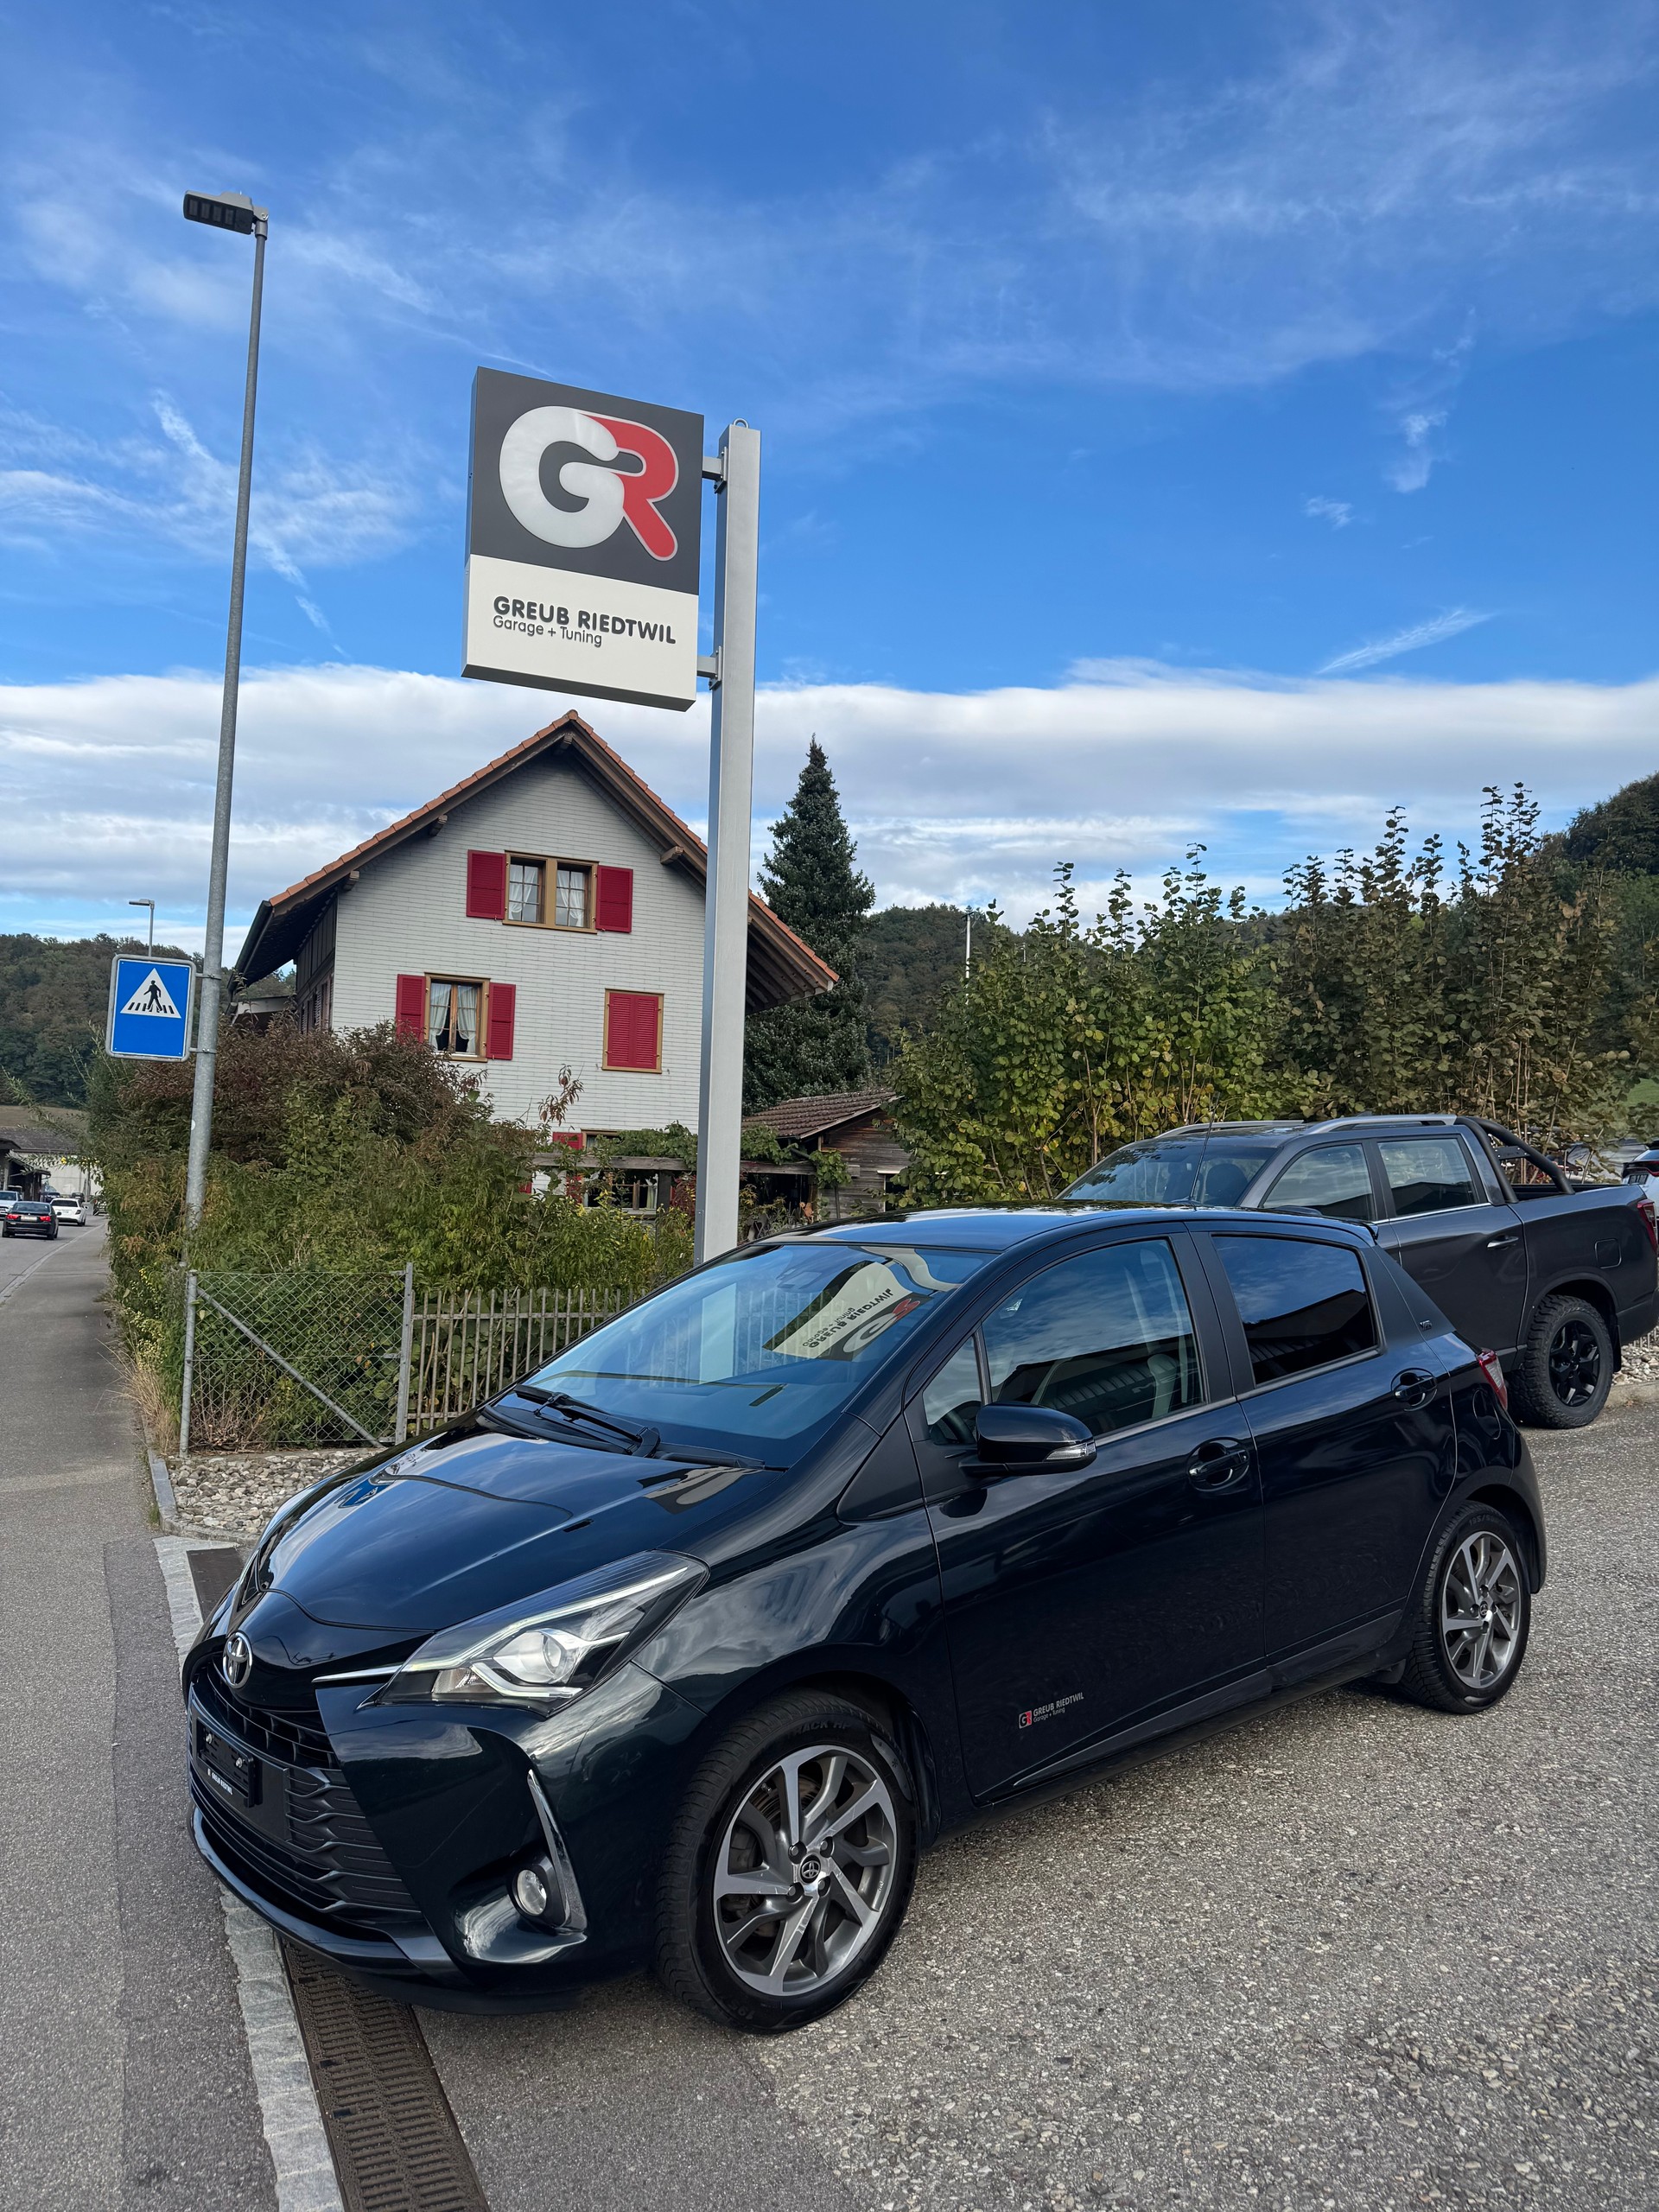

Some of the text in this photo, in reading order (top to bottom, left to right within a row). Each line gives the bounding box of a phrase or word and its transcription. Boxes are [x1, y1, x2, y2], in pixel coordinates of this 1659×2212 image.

[499, 405, 679, 562] GR
[493, 595, 677, 645] GREUB RIEDTWIL
[493, 614, 602, 648] Garage + Tuning
[1033, 1692, 1084, 1717] GREUB RIEDTWIL
[1033, 1714, 1048, 1723] Garage
